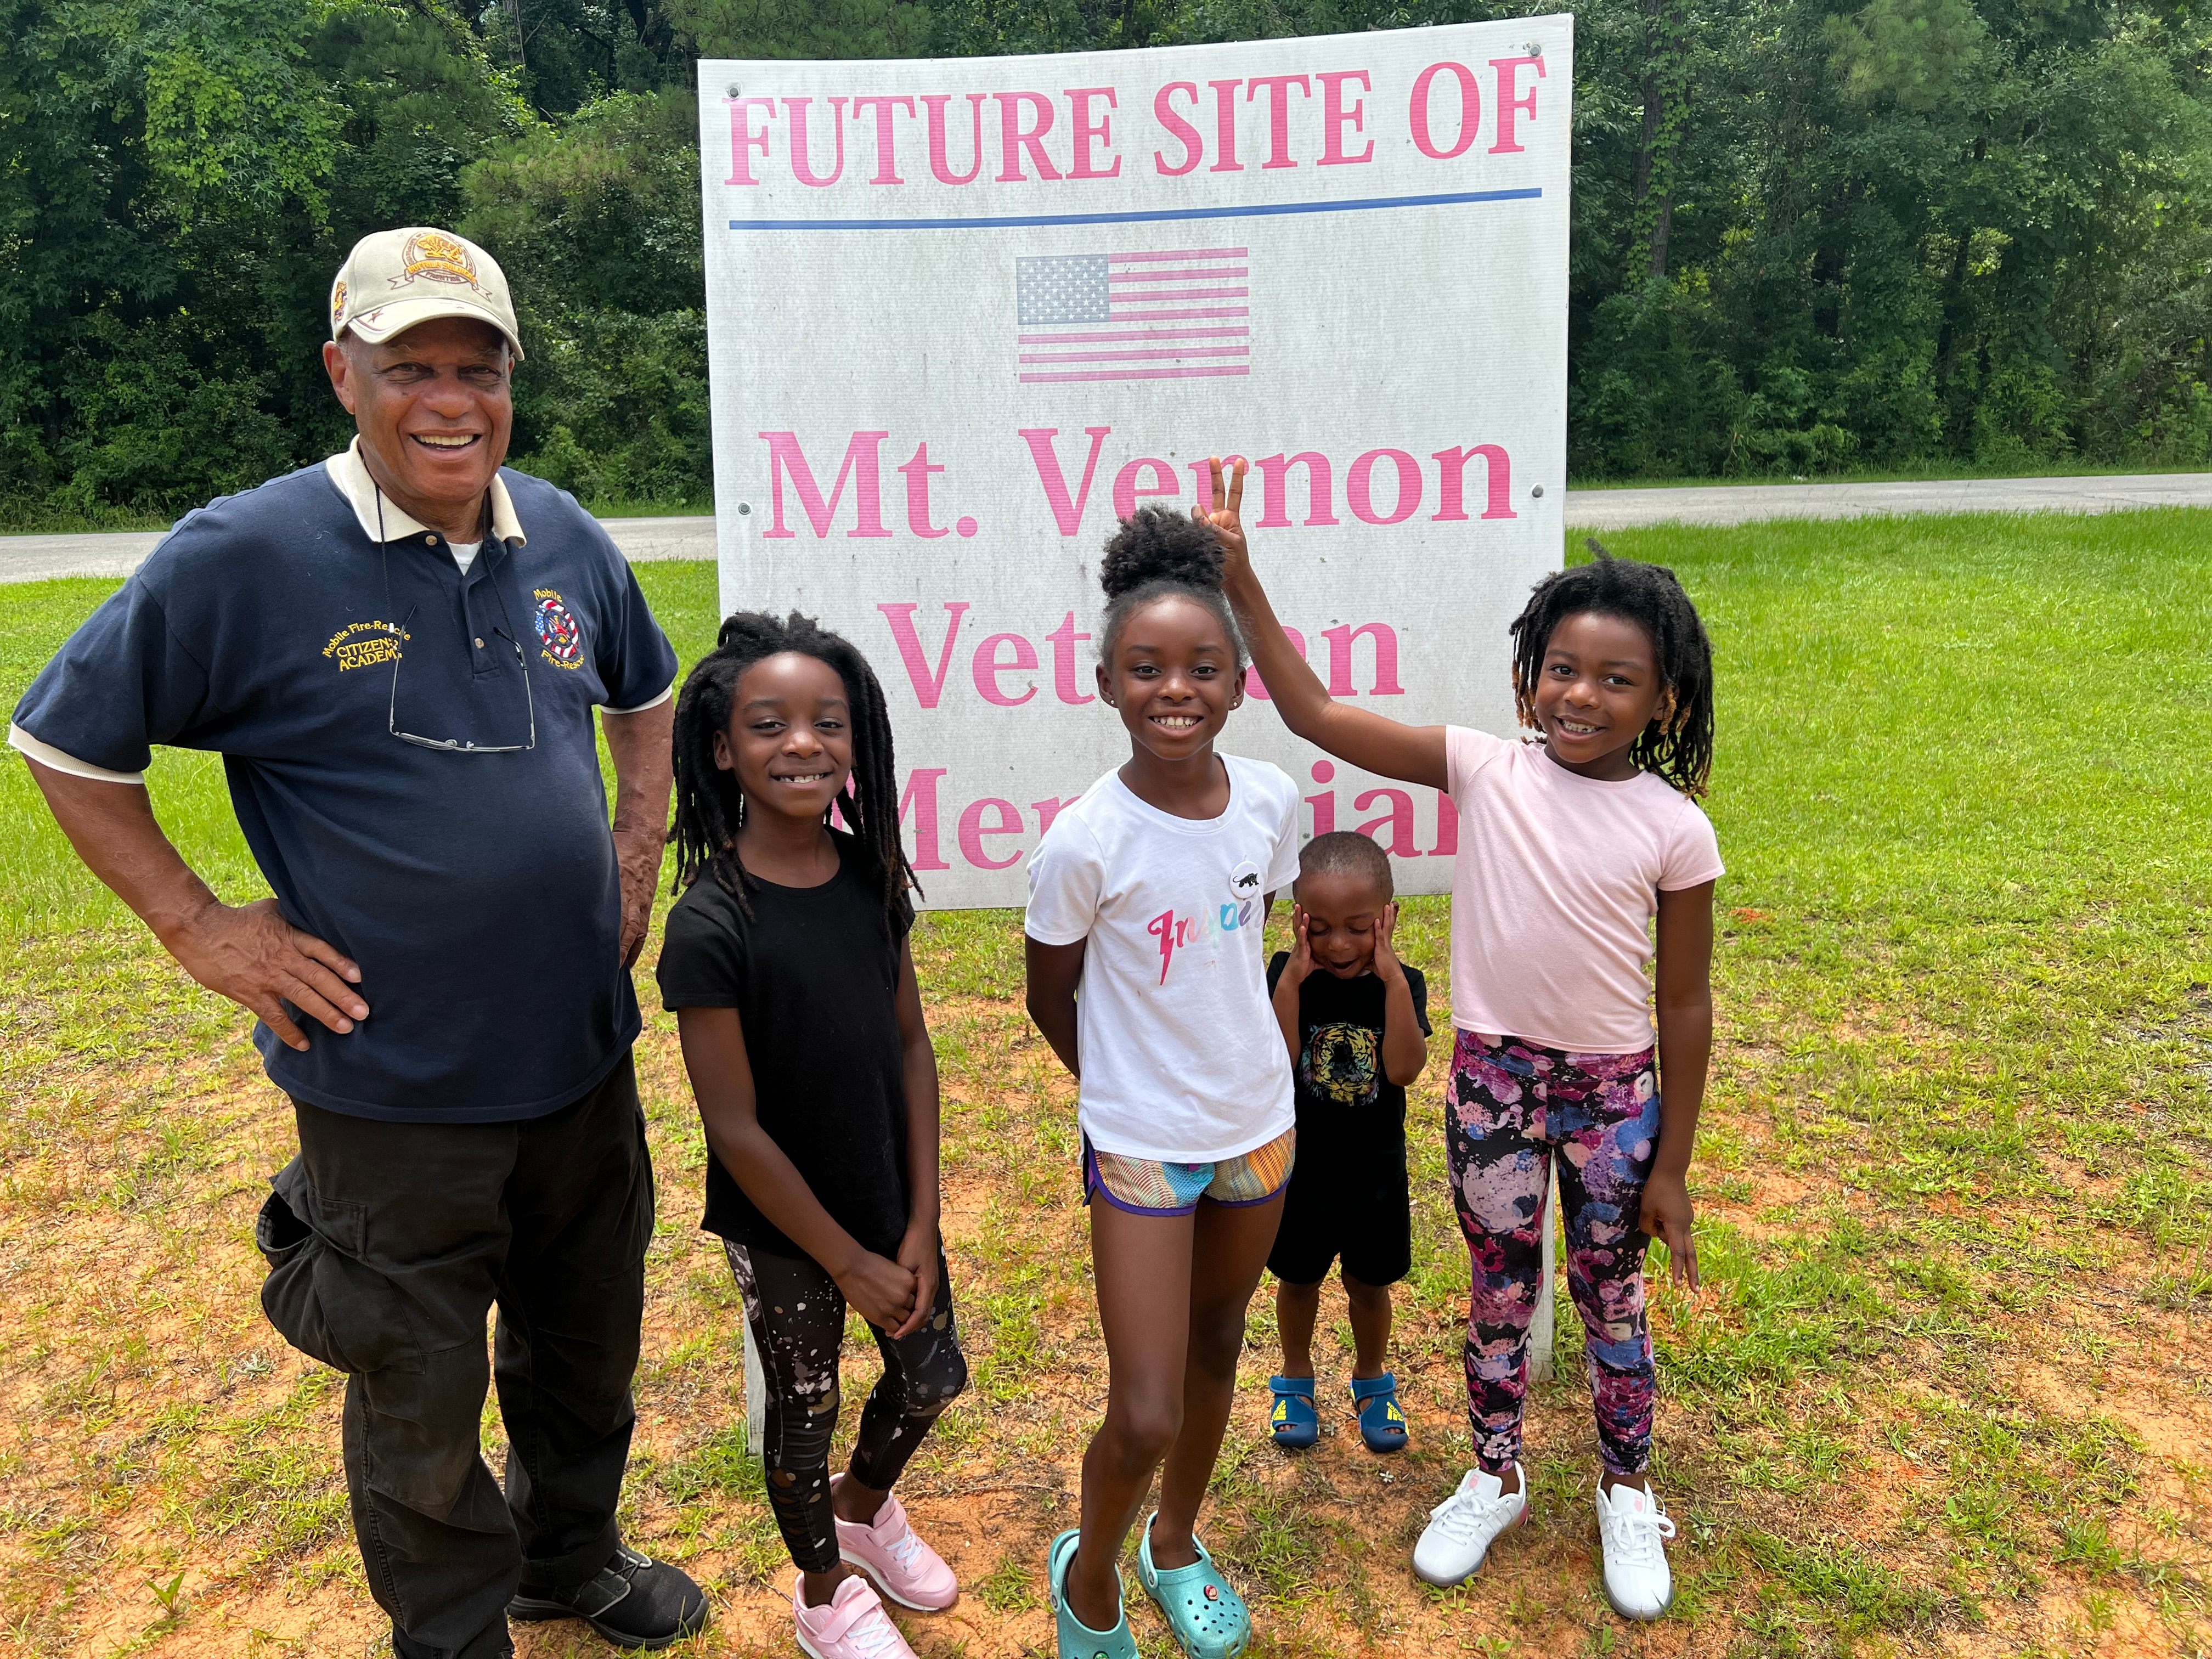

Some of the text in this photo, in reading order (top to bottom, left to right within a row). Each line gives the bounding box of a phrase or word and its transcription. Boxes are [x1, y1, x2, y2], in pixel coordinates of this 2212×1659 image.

[725, 57, 1547, 187] FUTURE SITE OF
[759, 427, 1517, 538] Mt. Vernon
[322, 619, 411, 658] Mobile Fire-Recue
[533, 588, 563, 603] Mobile
[877, 602, 1405, 709] Vetn
